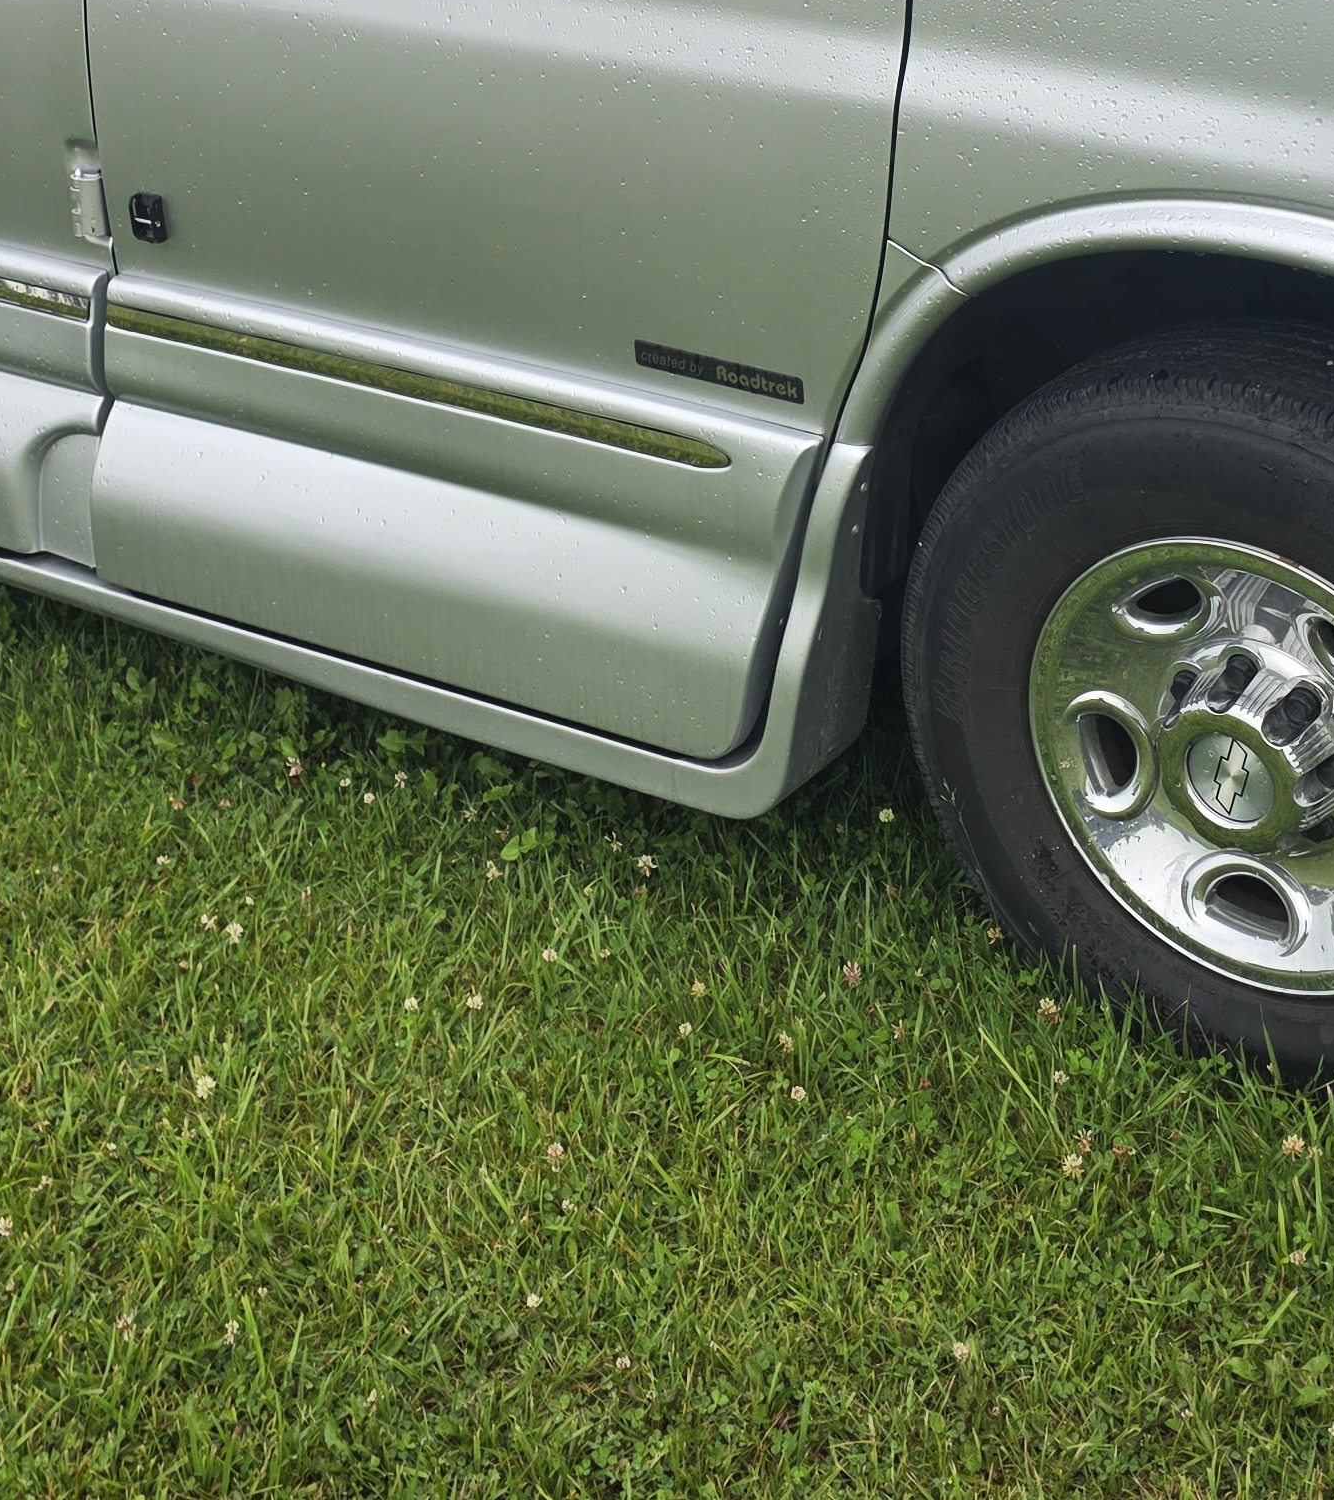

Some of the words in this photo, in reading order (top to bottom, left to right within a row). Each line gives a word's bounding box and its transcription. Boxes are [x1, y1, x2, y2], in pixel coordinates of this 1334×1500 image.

[640, 350, 686, 372] created
[689, 360, 704, 377] by
[715, 364, 799, 399] Roadtrek
[931, 460, 1087, 738] BRIDGESTONE
